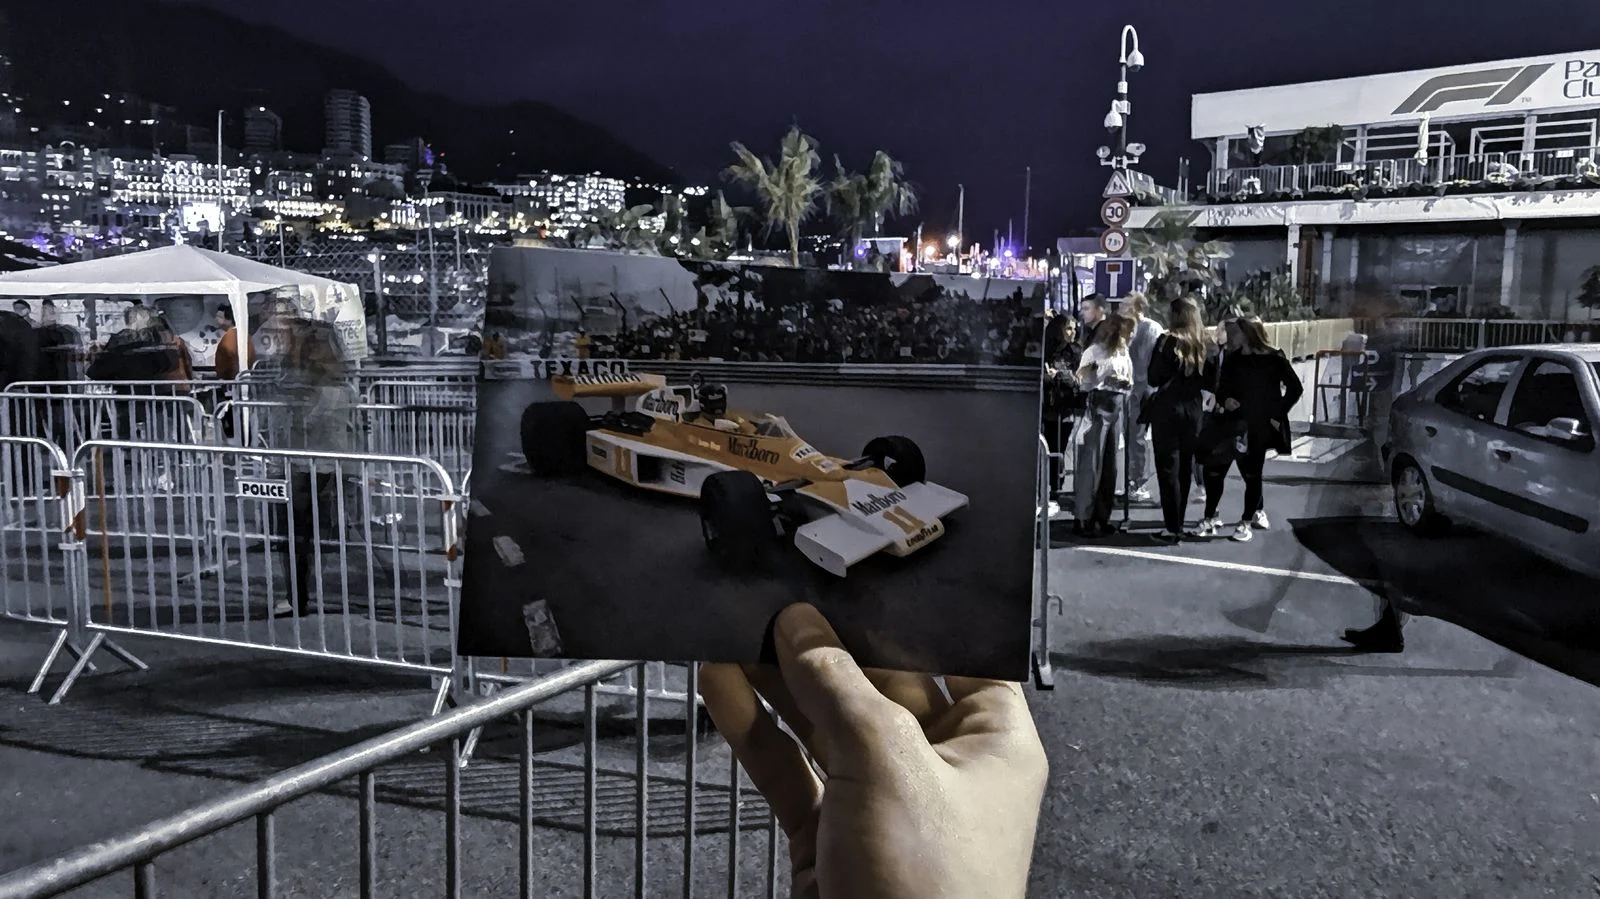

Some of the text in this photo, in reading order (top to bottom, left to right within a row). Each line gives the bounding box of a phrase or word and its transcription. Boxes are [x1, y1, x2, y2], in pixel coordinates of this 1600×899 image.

[1105, 206, 1124, 219] 30
[530, 359, 626, 379] TEXACO
[728, 436, 780, 465] Marlboro
[242, 483, 285, 497] POLICE
[852, 490, 908, 517] Marlboro
